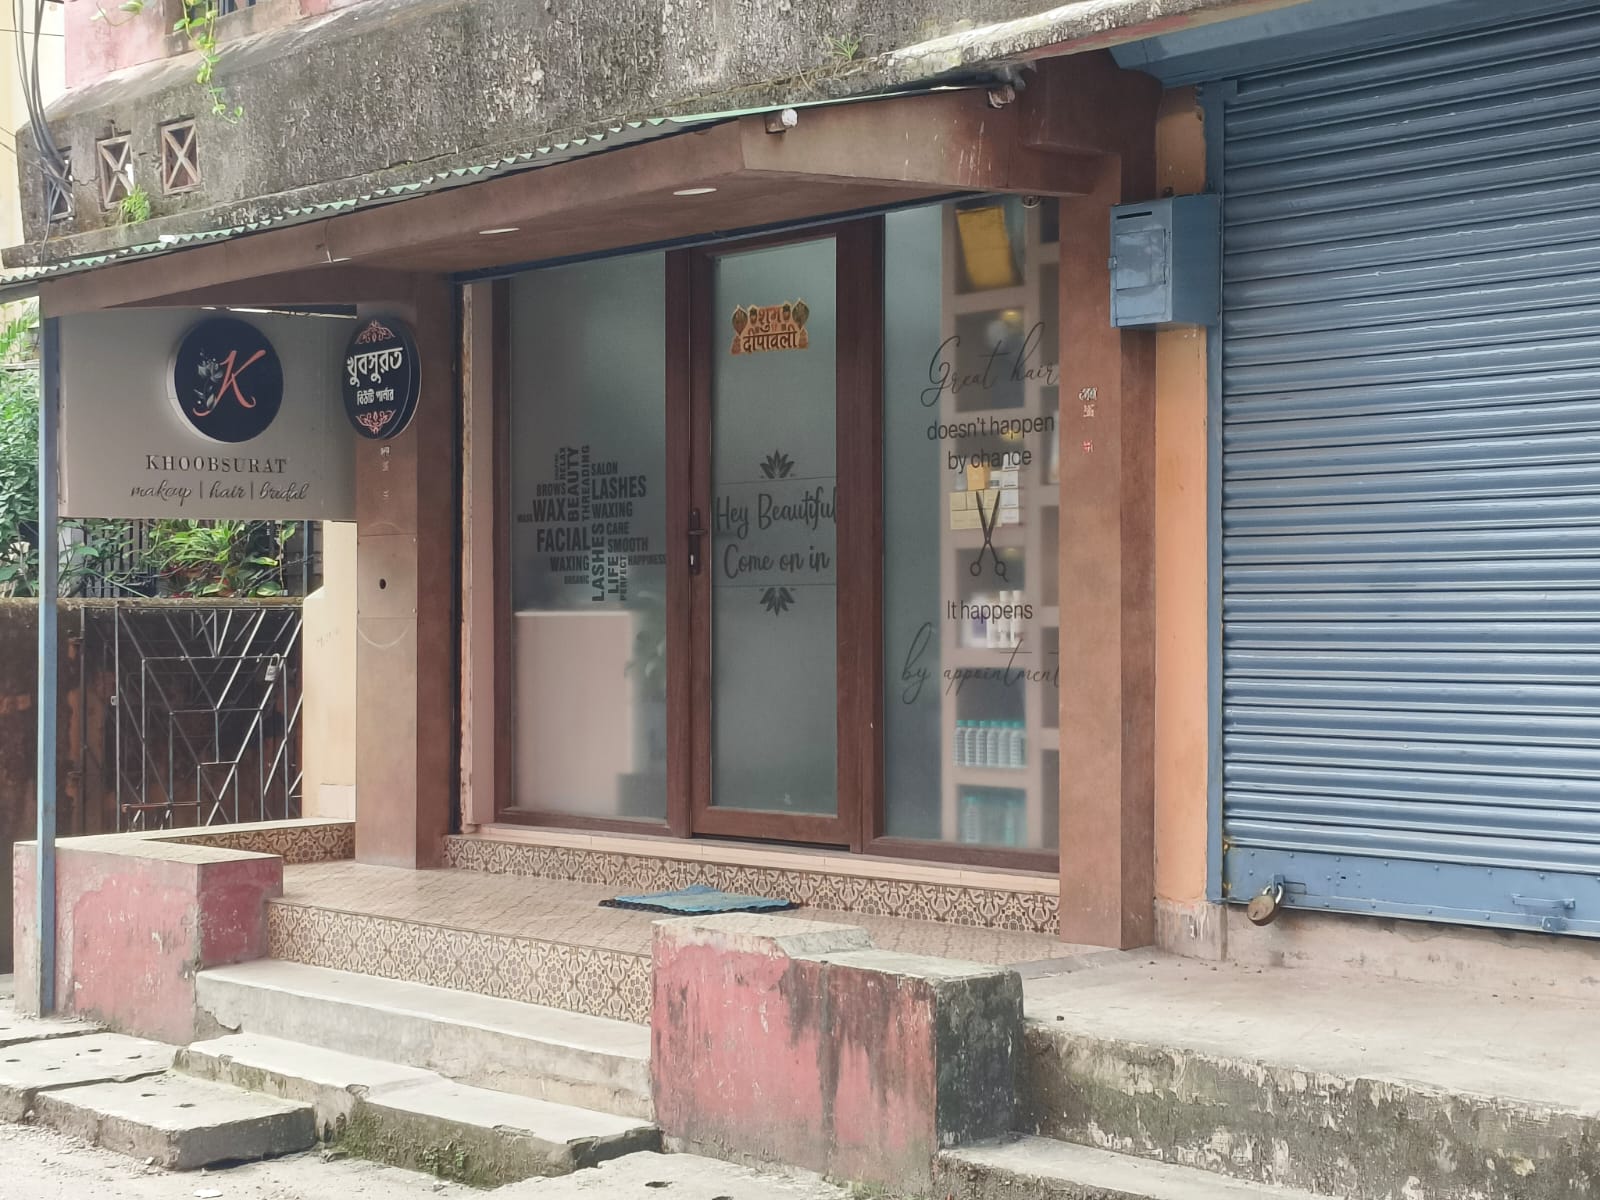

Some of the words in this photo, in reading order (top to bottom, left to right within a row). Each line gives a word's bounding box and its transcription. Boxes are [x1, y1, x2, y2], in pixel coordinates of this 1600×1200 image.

[758, 306, 781, 333] शुभ
[743, 324, 798, 353] दीपावली
[346, 347, 404, 388] খুবসুরত
[921, 336, 1008, 408] Great
[1009, 321, 1058, 385] hair
[927, 417, 986, 440] doesn't
[990, 415, 1055, 440] happen
[146, 454, 287, 474] KHOOBSURAT
[591, 461, 618, 476] SALON
[948, 451, 967, 474] by
[971, 449, 1032, 468] chance
[130, 480, 192, 507] makeup
[209, 480, 246, 499] hair
[259, 481, 310, 502] bridal
[536, 483, 566, 497] BROWS
[567, 447, 579, 522] BEAUTY
[581, 445, 590, 522] THREADING
[592, 475, 647, 500] LASHES
[533, 498, 566, 523] WAX
[592, 502, 632, 519] WAXING
[716, 496, 749, 540] Hey
[758, 485, 837, 531] Beautiful
[536, 527, 591, 553] FACIAL
[606, 522, 630, 536] CARE
[608, 537, 649, 553] SMOOTH
[550, 555, 590, 572] WAXING
[592, 523, 605, 602] LASHES
[724, 543, 774, 579] Come
[779, 552, 804, 574] on
[809, 545, 831, 573] in
[607, 555, 619, 594] LIFE
[619, 555, 628, 601] PERFECT
[947, 600, 957, 620] It
[960, 600, 1033, 625] happens
[902, 622, 932, 705] by
